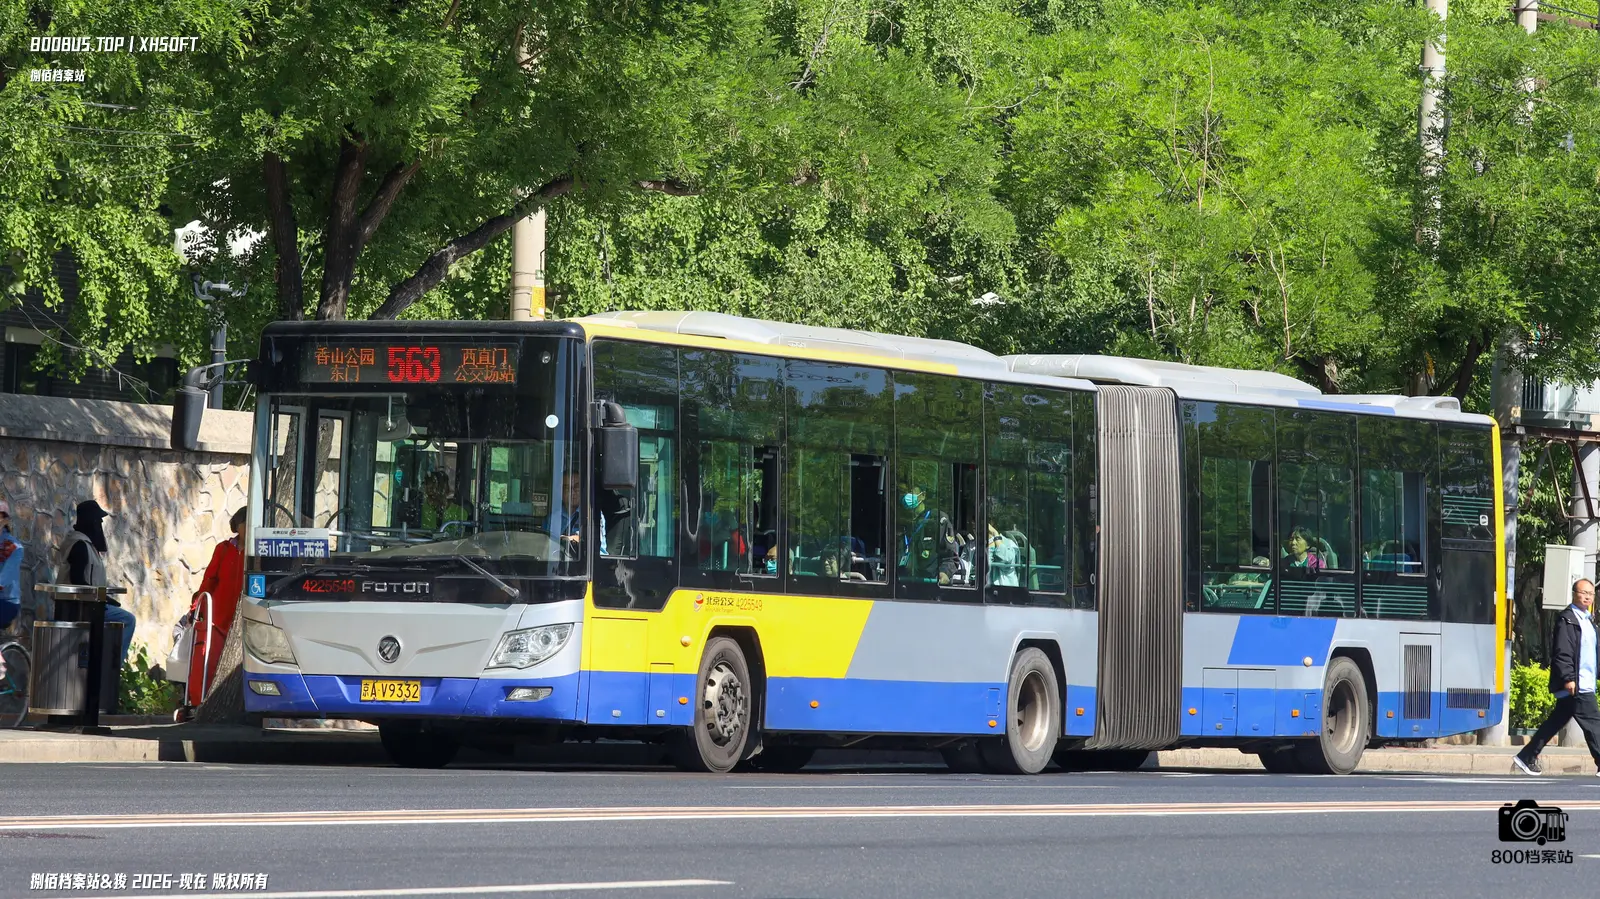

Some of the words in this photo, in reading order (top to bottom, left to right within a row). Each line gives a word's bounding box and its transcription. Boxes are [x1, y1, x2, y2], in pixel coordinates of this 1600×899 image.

[315, 347, 375, 365] 香山公园
[387, 346, 441, 382] 563
[461, 348, 508, 365] 西直门
[330, 365, 360, 382] 东门
[454, 364, 515, 383] 公交场站
[302, 579, 355, 593] 4225549
[362, 581, 430, 594] FOTON
[706, 596, 734, 607] 北京公交
[736, 597, 763, 612] 4225549
